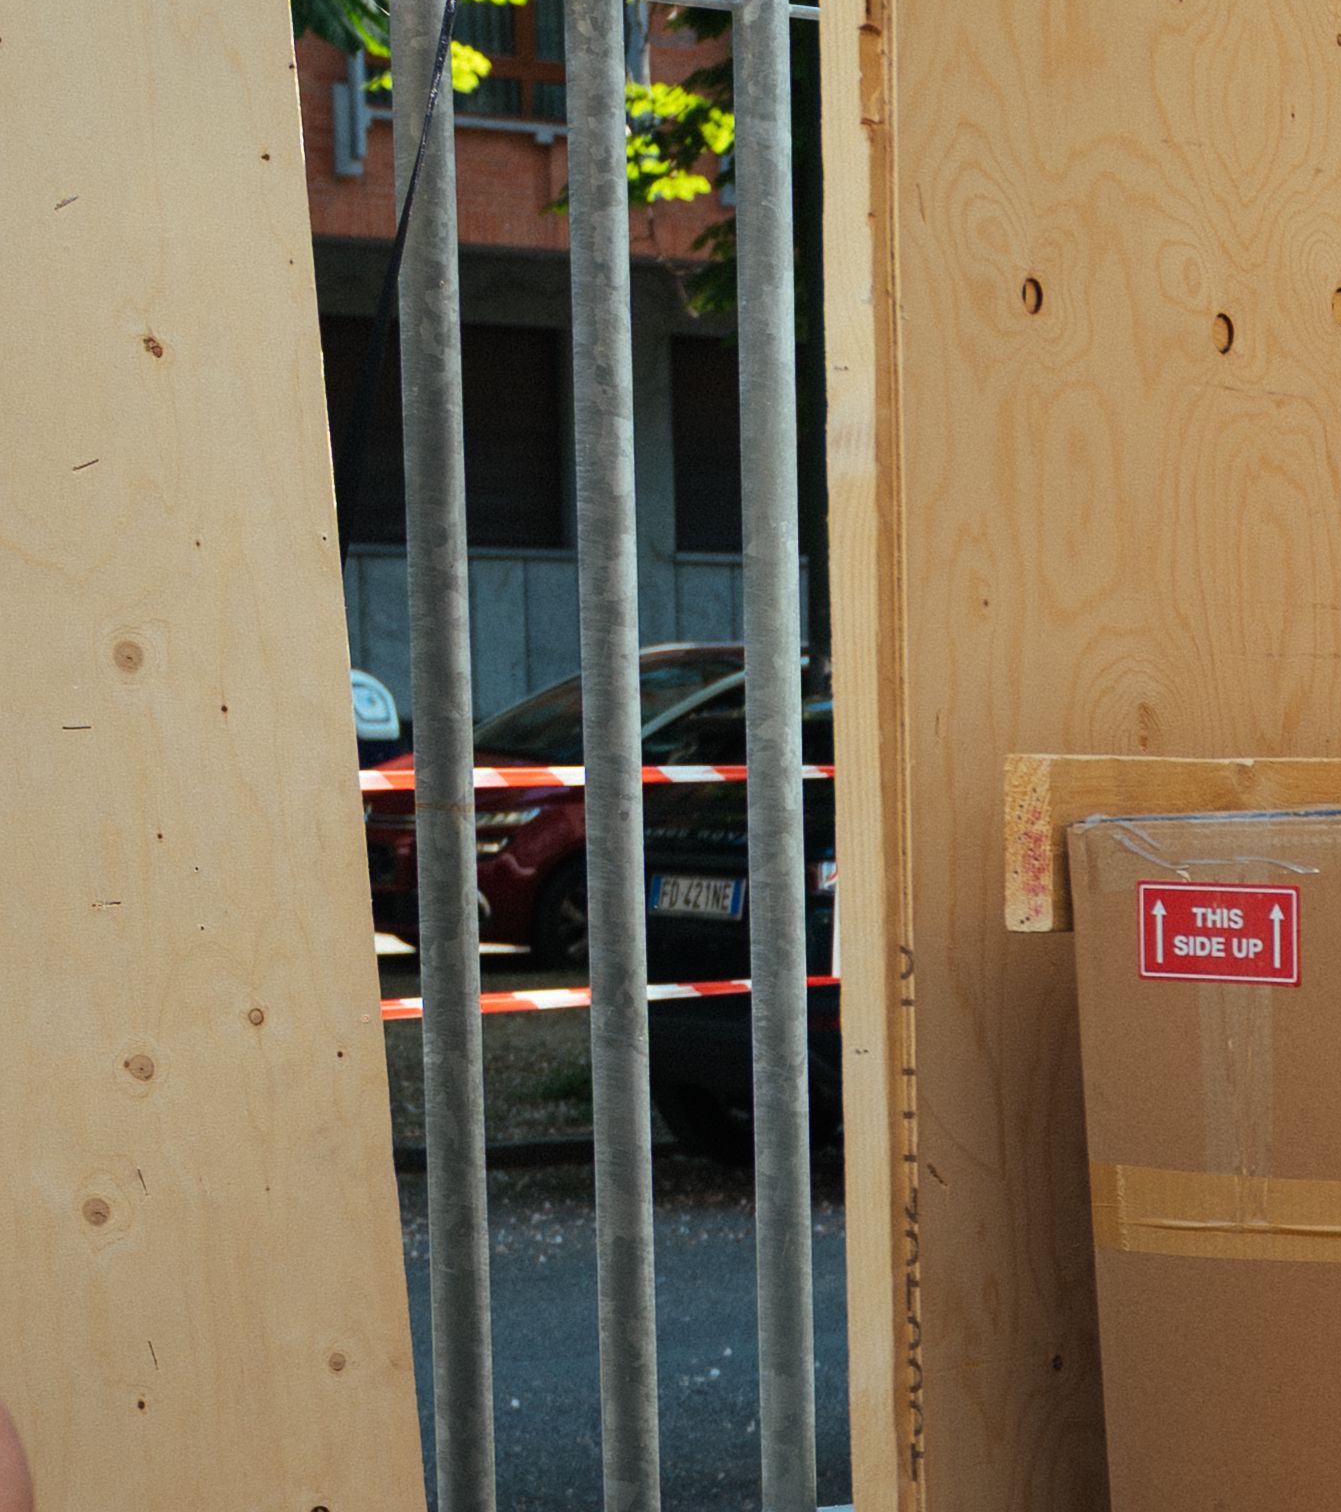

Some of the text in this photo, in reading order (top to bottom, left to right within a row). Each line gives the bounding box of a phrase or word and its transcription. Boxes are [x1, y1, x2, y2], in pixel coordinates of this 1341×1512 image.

[1191, 907, 1244, 929] THIS
[1173, 935, 1264, 959] SIDE UP
